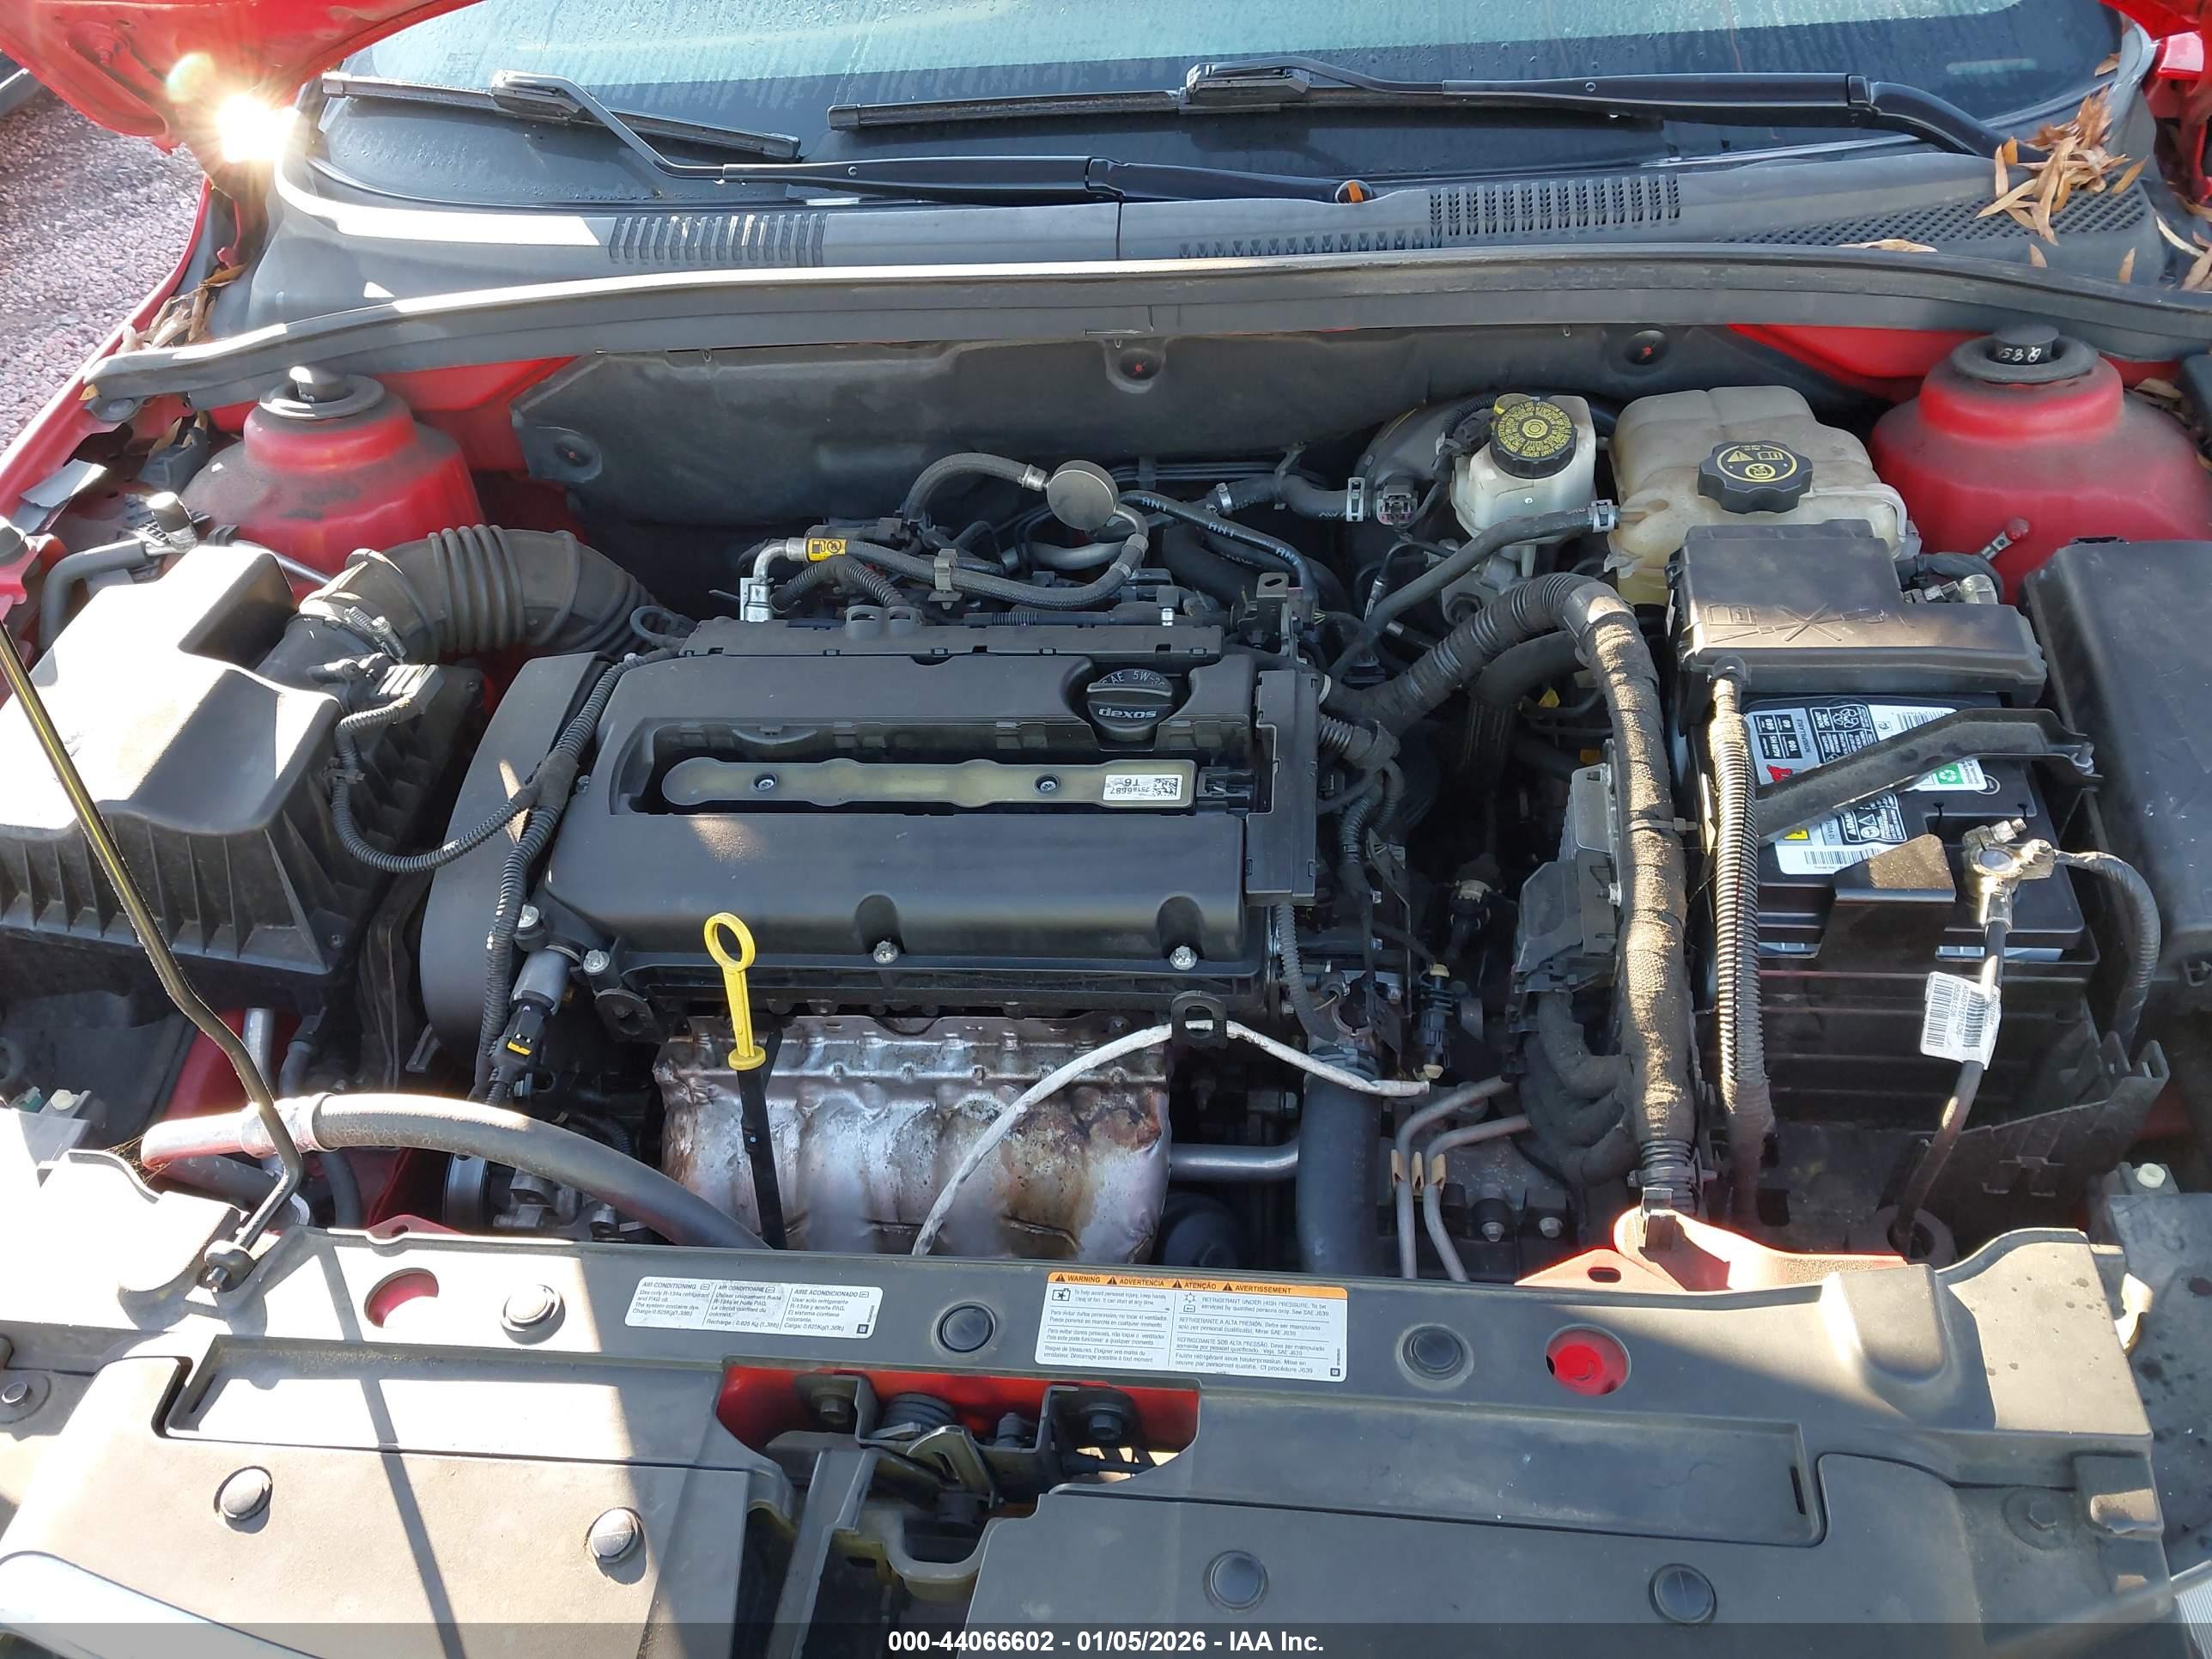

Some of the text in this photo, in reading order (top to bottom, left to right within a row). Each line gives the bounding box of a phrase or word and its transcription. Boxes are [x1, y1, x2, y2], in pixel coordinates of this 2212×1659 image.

[1098, 707, 1158, 719] dexos
[1765, 718, 1775, 731] 680
[1782, 720, 1791, 728] 60
[1788, 740, 1799, 752] 100
[1067, 1274, 1101, 1283] WARNING
[1119, 1279, 1164, 1287] ADVERTENCIA
[1184, 1281, 1217, 1291] ATENÇÃO
[1235, 1285, 1292, 1295] AVERTISSEMENT
